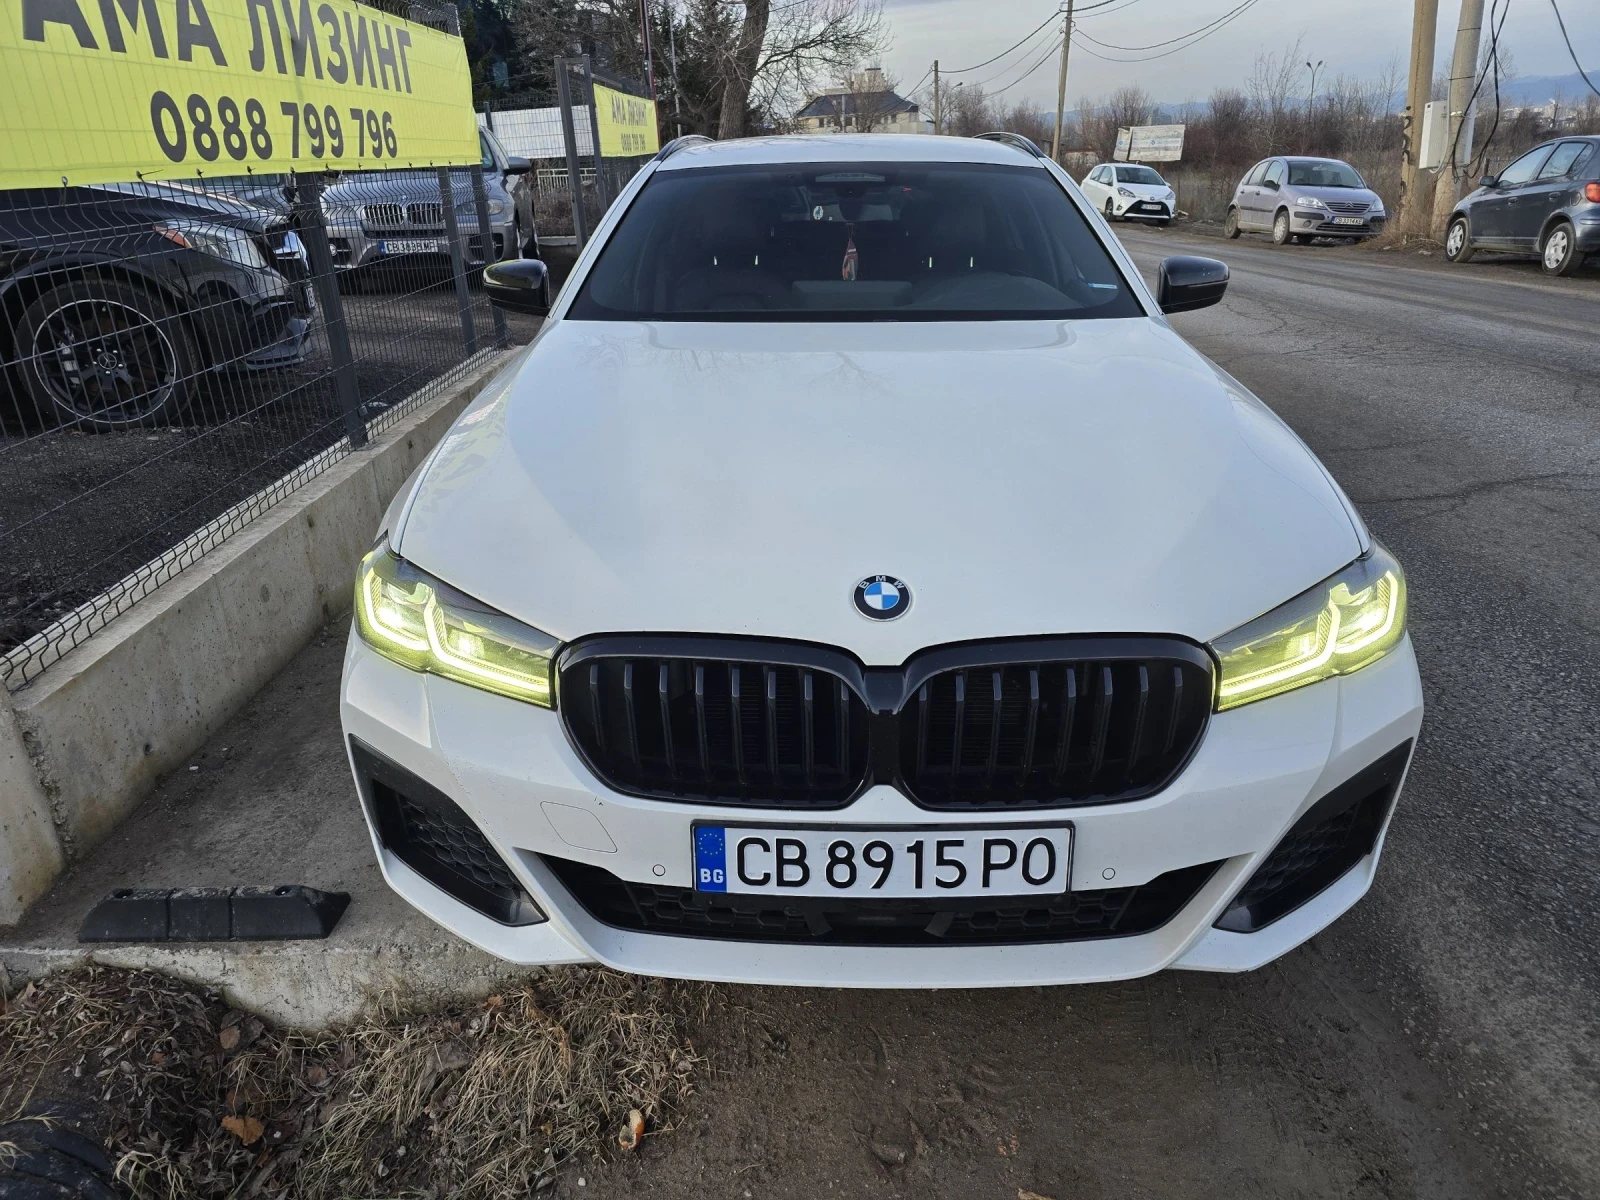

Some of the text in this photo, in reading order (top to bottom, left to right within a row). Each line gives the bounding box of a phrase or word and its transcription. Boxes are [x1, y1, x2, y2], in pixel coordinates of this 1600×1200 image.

[248, 0, 412, 94] ЛИЗИНГ
[150, 90, 398, 162] 0888 799 796
[859, 575, 905, 589] BMW
[700, 868, 724, 884] BG
[736, 837, 810, 888] CB
[825, 839, 967, 890] 8915
